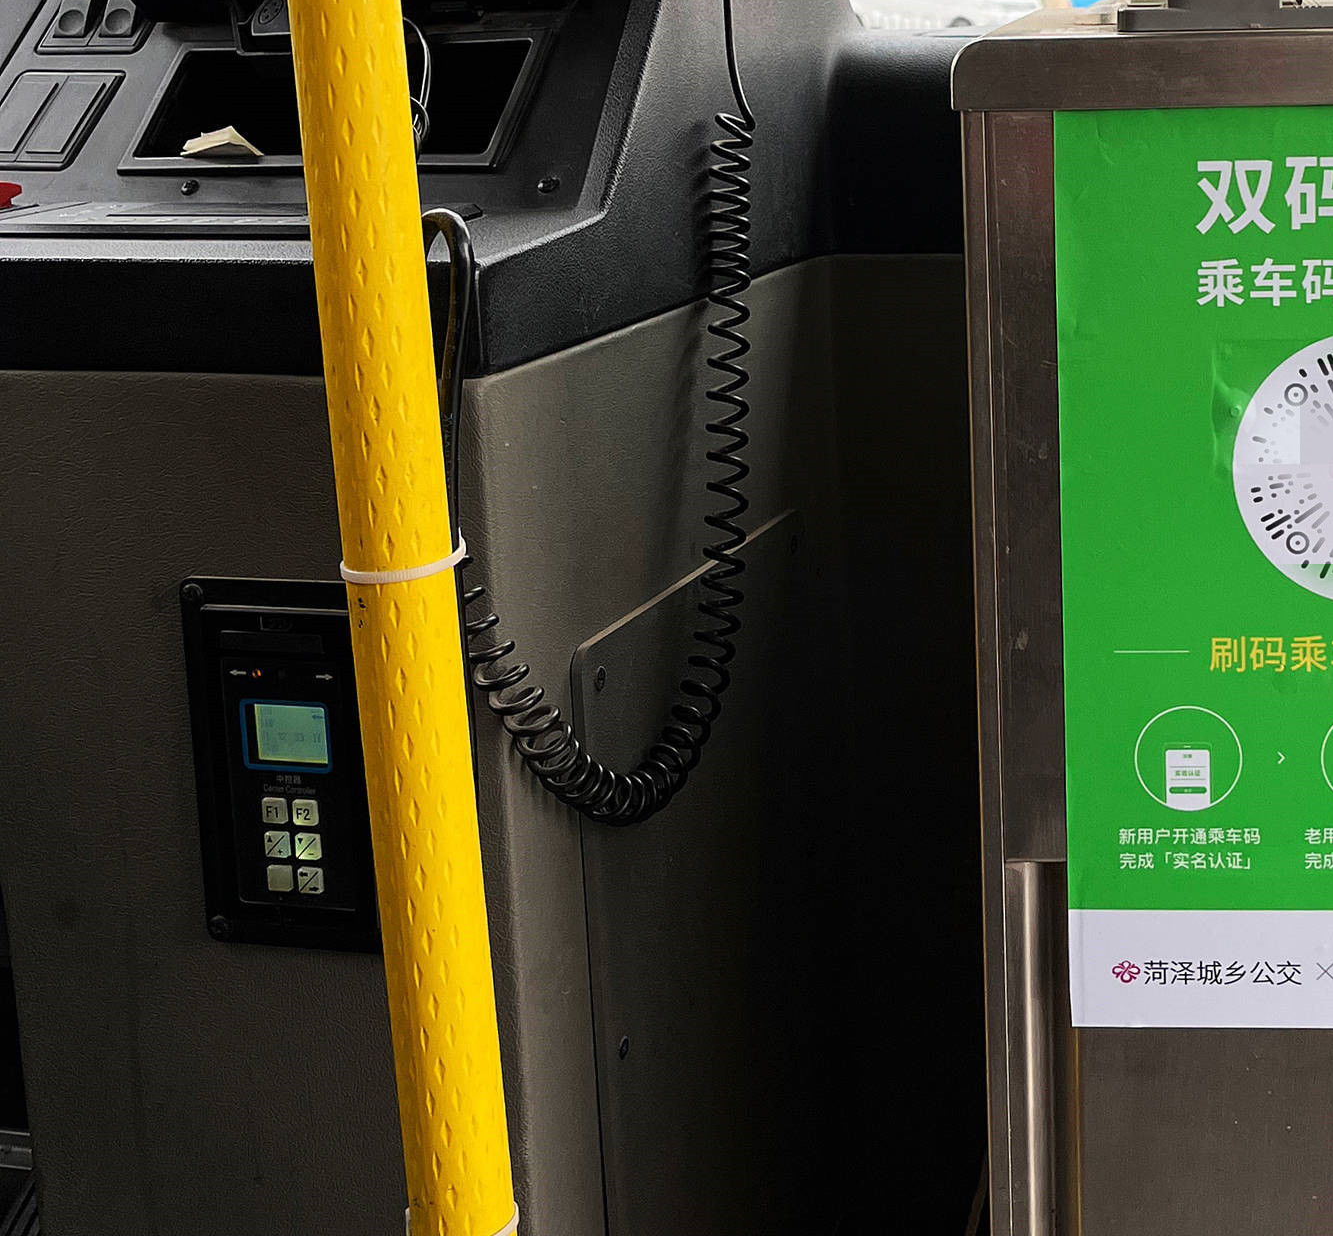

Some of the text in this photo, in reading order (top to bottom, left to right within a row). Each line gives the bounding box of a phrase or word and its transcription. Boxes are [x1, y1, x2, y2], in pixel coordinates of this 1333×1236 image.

[265, 805, 311, 821] F1 F2
[1118, 827, 1261, 846] 新用户开通乘车码
[1143, 960, 1303, 988] 菏泽城乡公交
